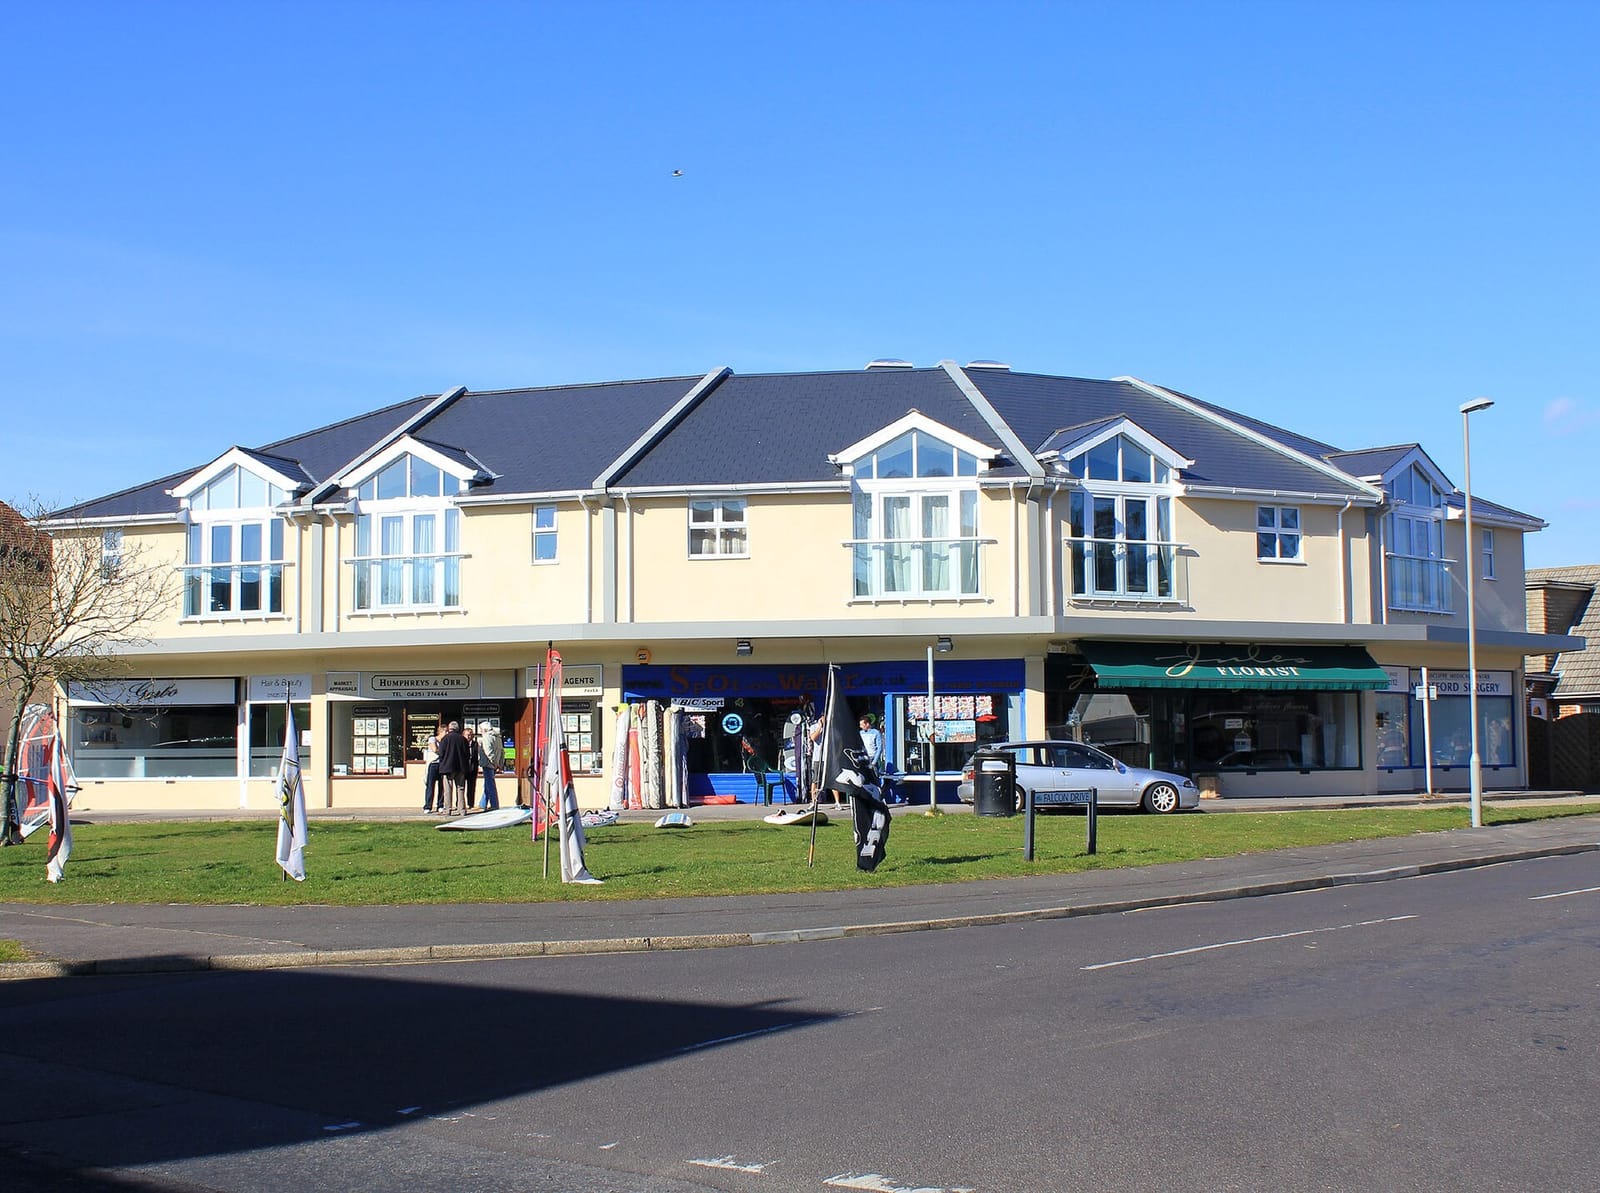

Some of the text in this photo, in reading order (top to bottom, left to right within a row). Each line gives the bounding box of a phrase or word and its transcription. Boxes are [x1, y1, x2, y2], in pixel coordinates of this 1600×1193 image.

[1216, 666, 1300, 676] FLORIST
[380, 679, 430, 687] HUMPHREYS
[443, 678, 461, 686] ORR
[564, 677, 594, 685] AGENTS
[1463, 682, 1500, 693] SGERY
[702, 699, 724, 707] Sport
[1043, 792, 1089, 801] FALCON DRIVE
